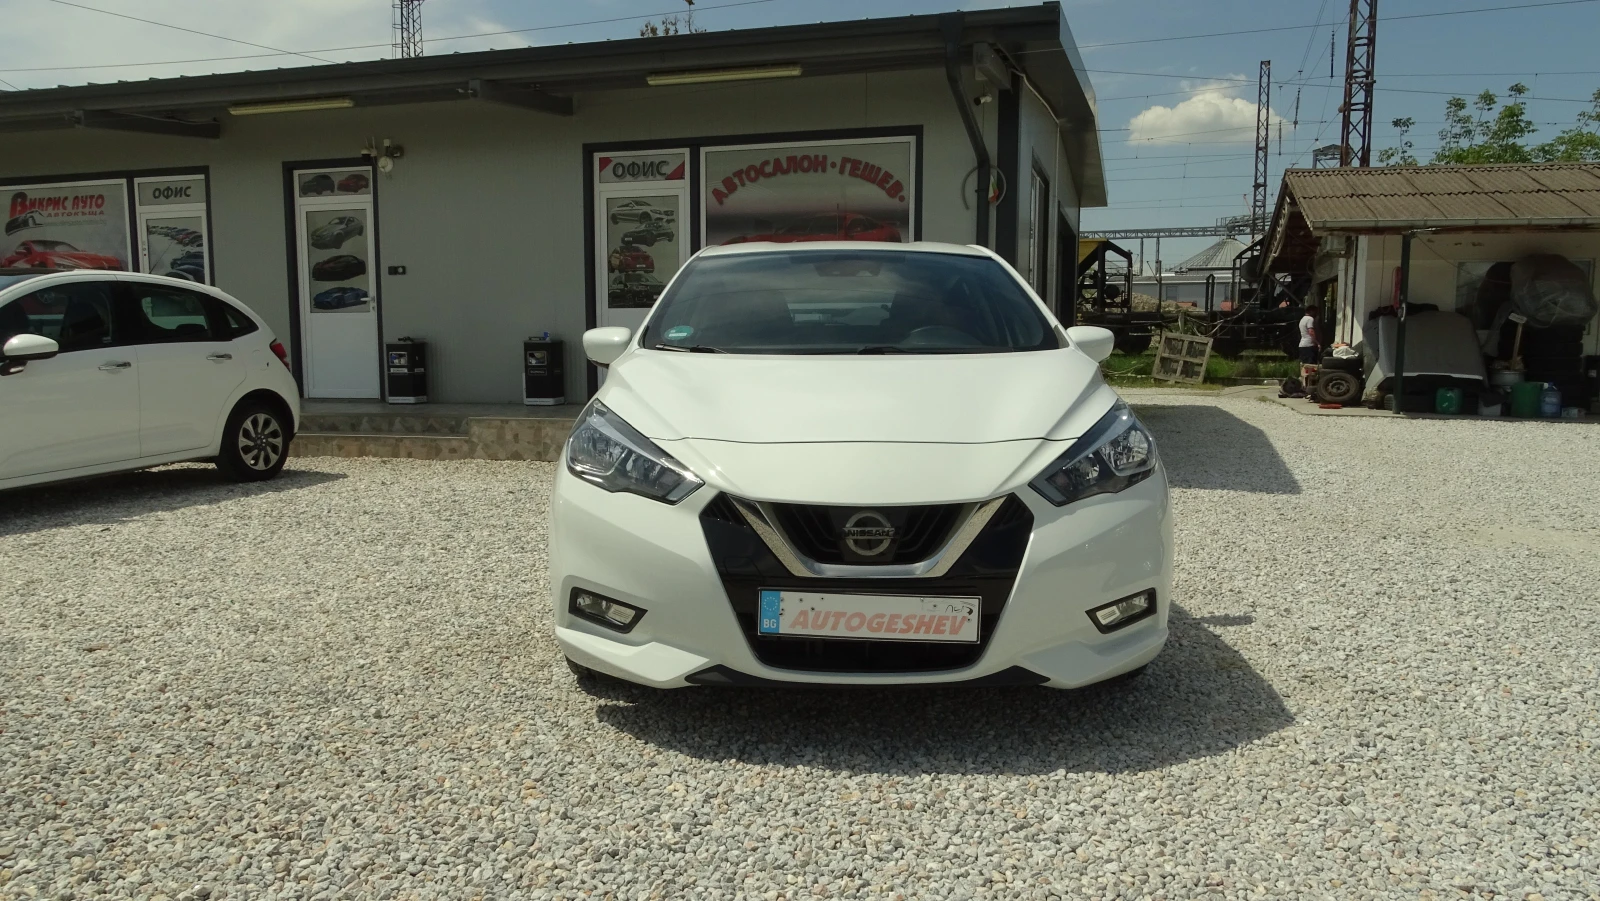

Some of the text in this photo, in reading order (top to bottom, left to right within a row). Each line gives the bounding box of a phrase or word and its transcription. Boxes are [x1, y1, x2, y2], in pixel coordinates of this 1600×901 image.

[612, 160, 668, 178] ОФИС
[711, 154, 826, 205] АВТОСАЛОН
[152, 185, 191, 199] ОФИС
[847, 529, 890, 537] NISSAN
[763, 619, 777, 628] BG
[788, 610, 967, 635] AUTOGESHEV
